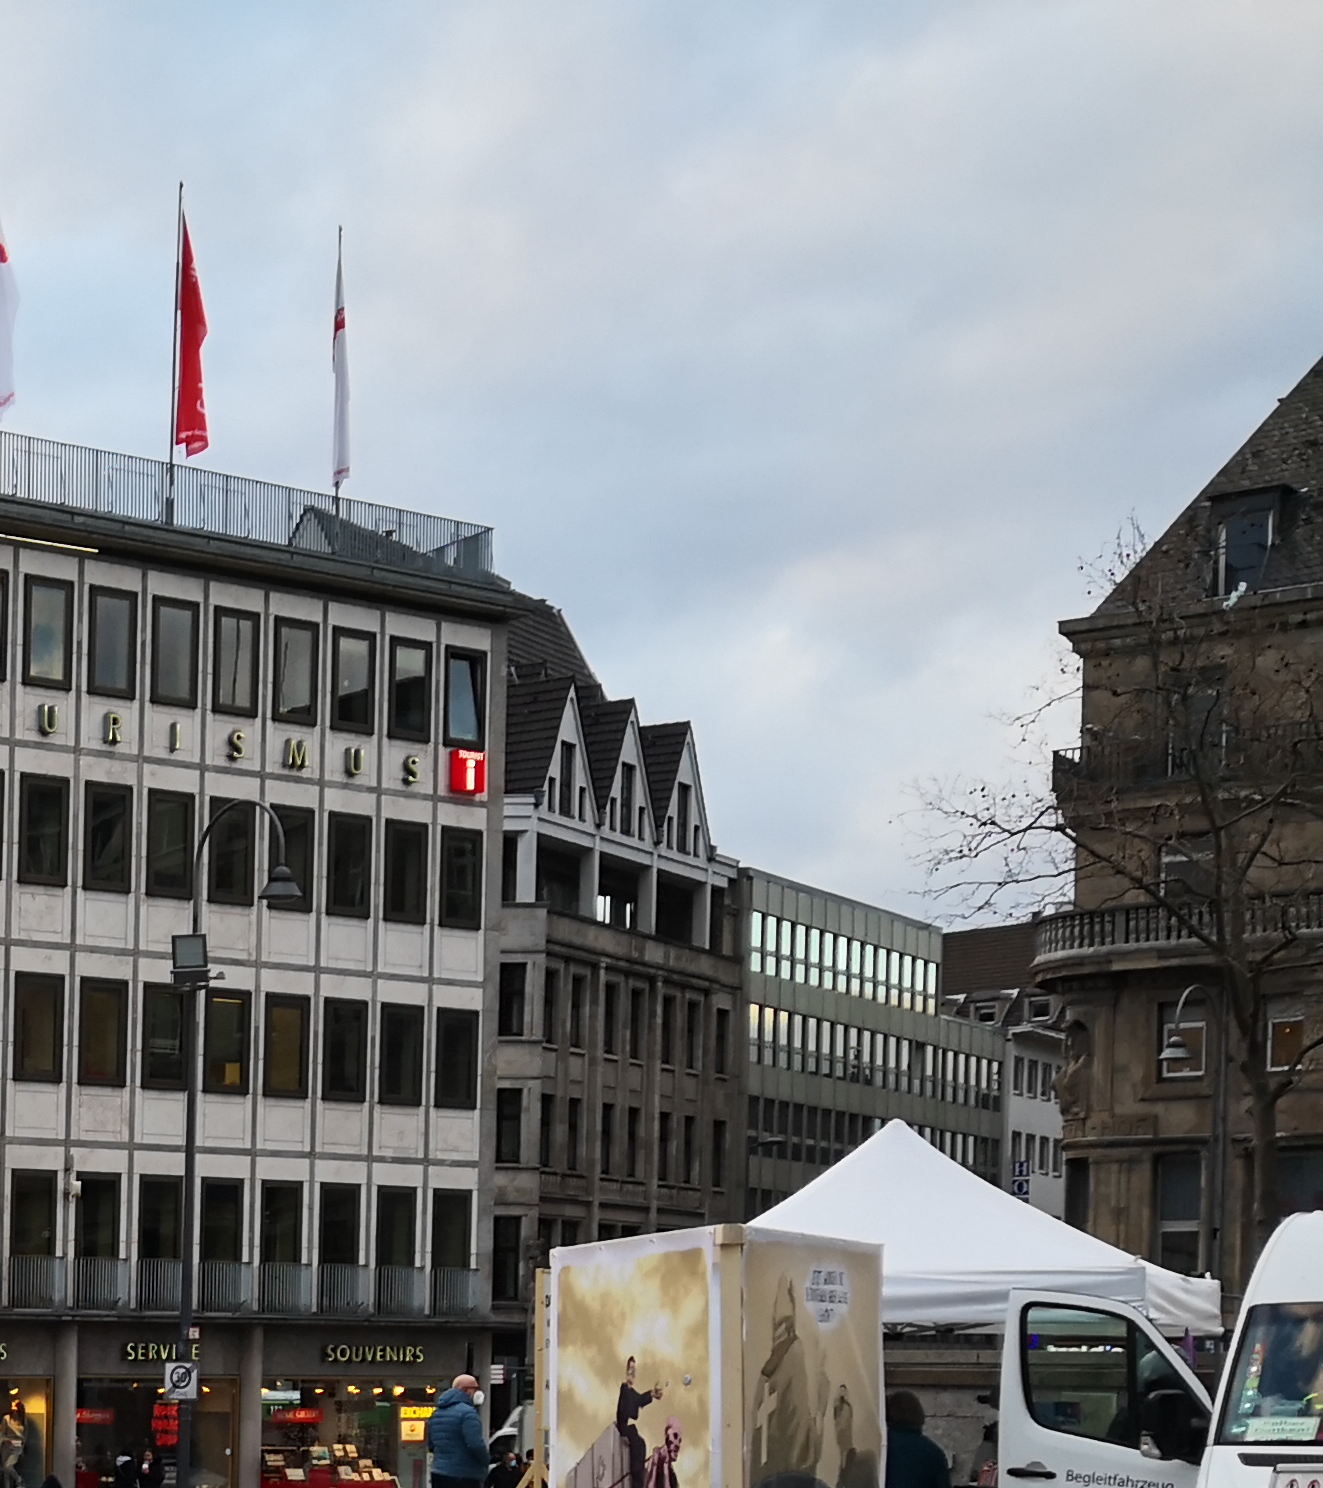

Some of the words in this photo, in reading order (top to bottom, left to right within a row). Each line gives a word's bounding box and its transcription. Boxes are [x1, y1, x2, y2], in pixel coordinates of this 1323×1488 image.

[458, 750, 483, 761] TOURIST
[1014, 1161, 1028, 1195] HO
[126, 1342, 201, 1360] SERVIE
[325, 1344, 424, 1363] SOUVENIRS
[174, 1371, 188, 1384] 30
